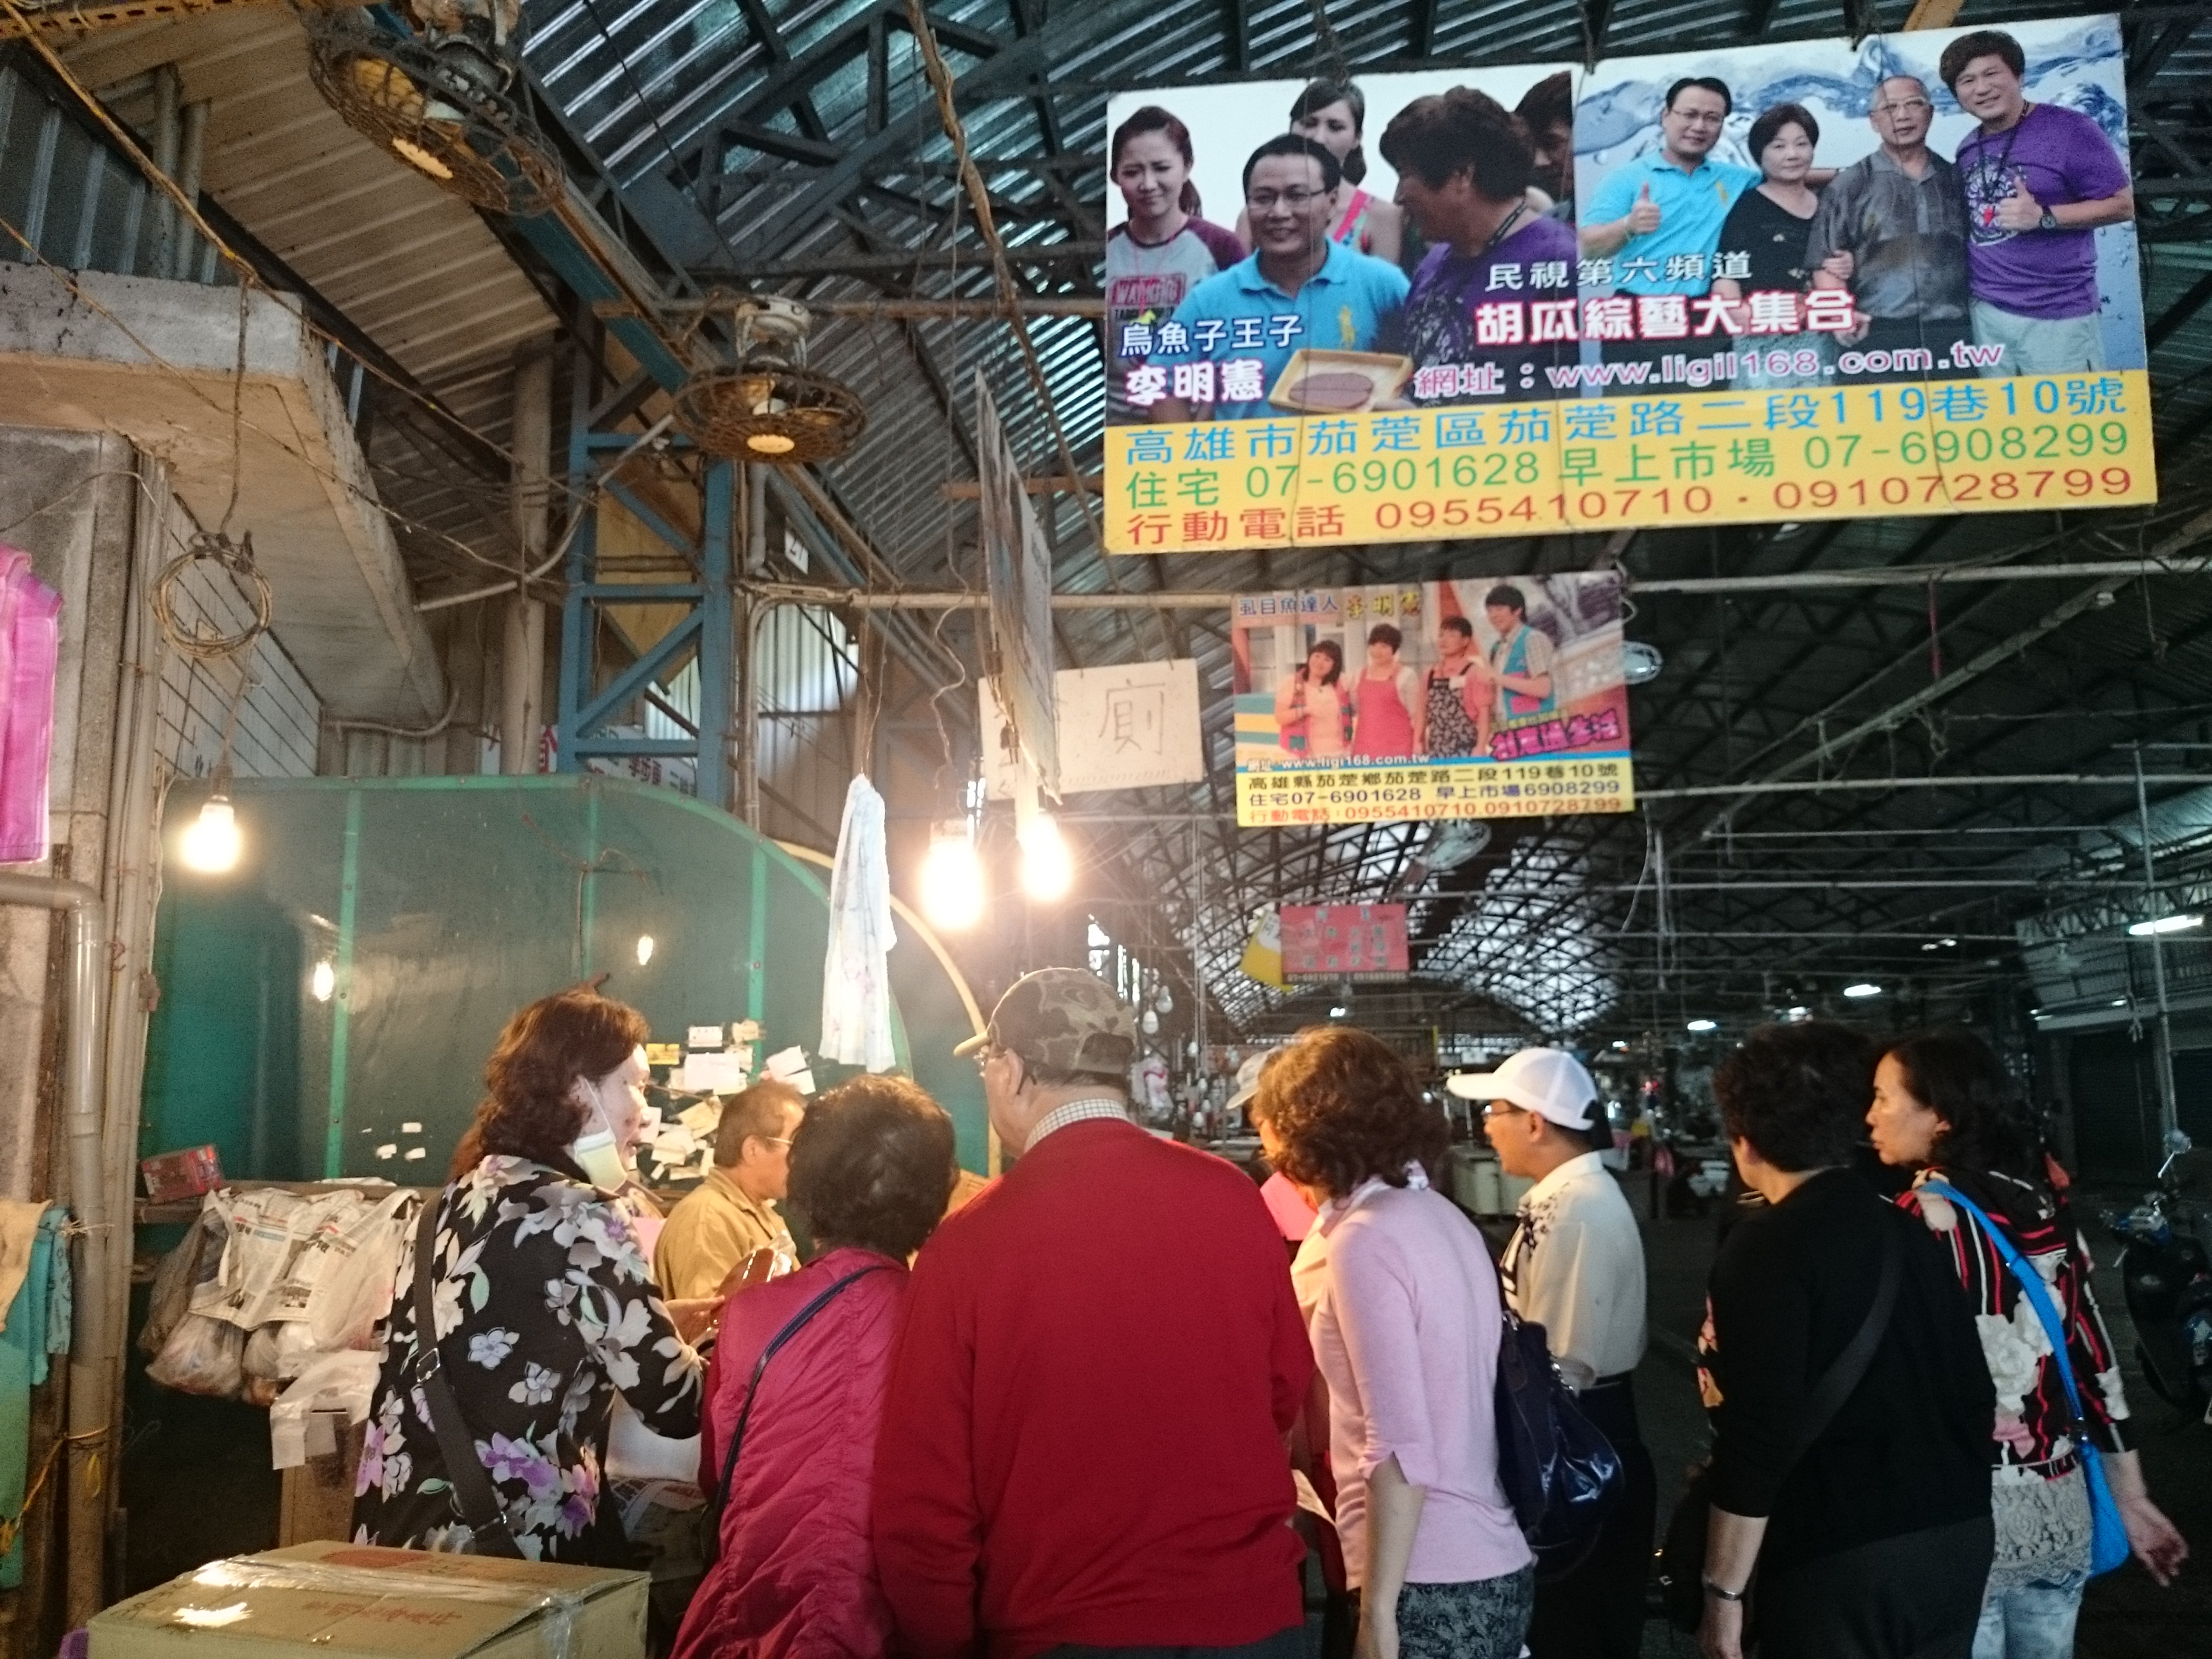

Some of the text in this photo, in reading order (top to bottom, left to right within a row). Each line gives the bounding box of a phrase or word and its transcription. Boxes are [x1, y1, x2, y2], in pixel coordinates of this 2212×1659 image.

[1485, 249, 1753, 292] 民視第六頻道
[1474, 287, 1856, 346] 胡瓜綜藝大集合
[1125, 358, 1265, 407] 李明憲
[1126, 420, 2129, 510] 住宅 07-6901628 早上市場 07-6908299
[1127, 505, 1345, 546] 行動電話
